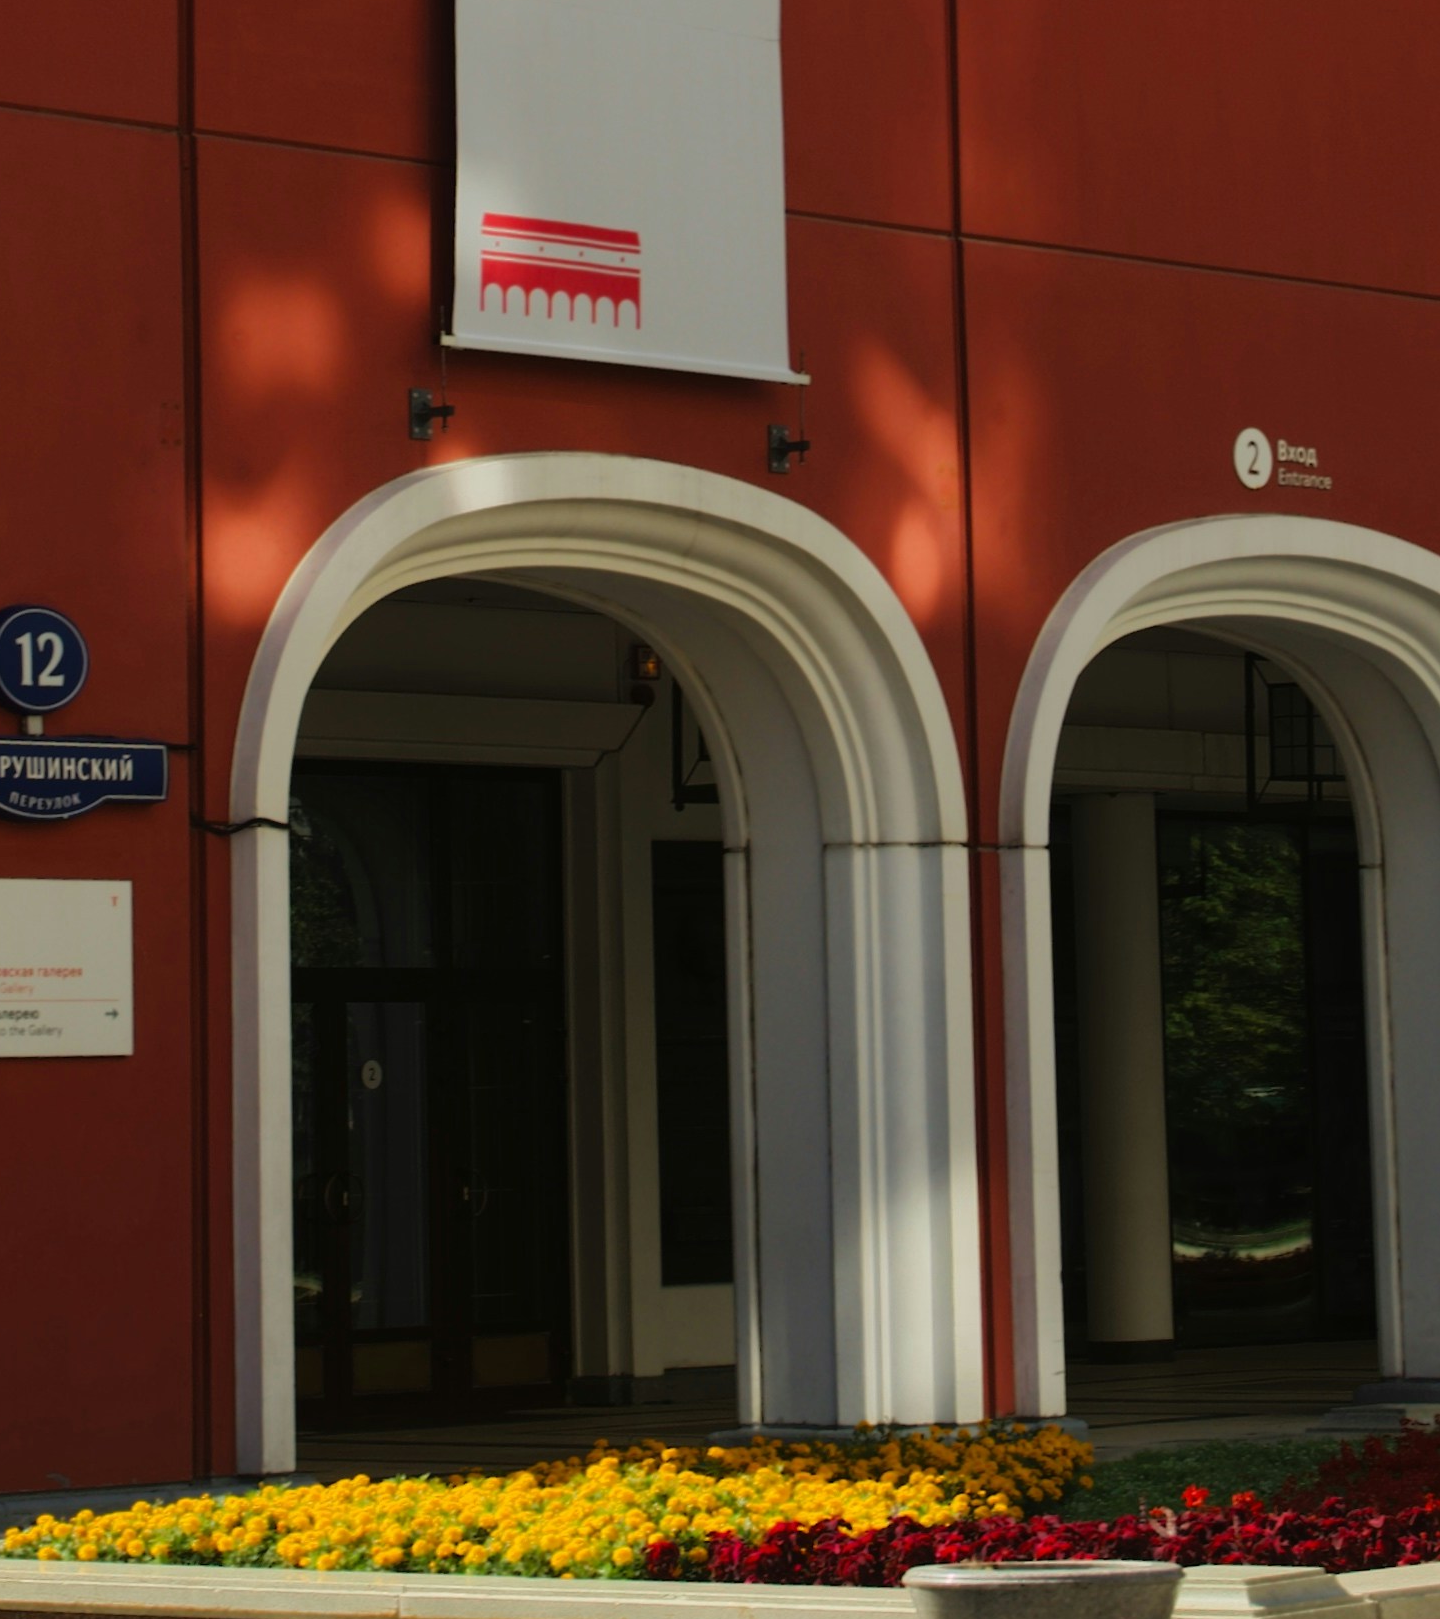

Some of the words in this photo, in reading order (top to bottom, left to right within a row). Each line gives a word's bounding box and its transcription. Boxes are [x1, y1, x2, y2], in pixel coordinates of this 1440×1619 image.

[1247, 440, 1260, 475] 2
[1277, 438, 1317, 467] Вход
[1278, 468, 1332, 489] Entrance
[15, 631, 65, 687] 12
[8, 791, 81, 810] ПЕРЕУЛОК
[38, 967, 83, 980] галерея
[369, 1068, 377, 1081] 2
